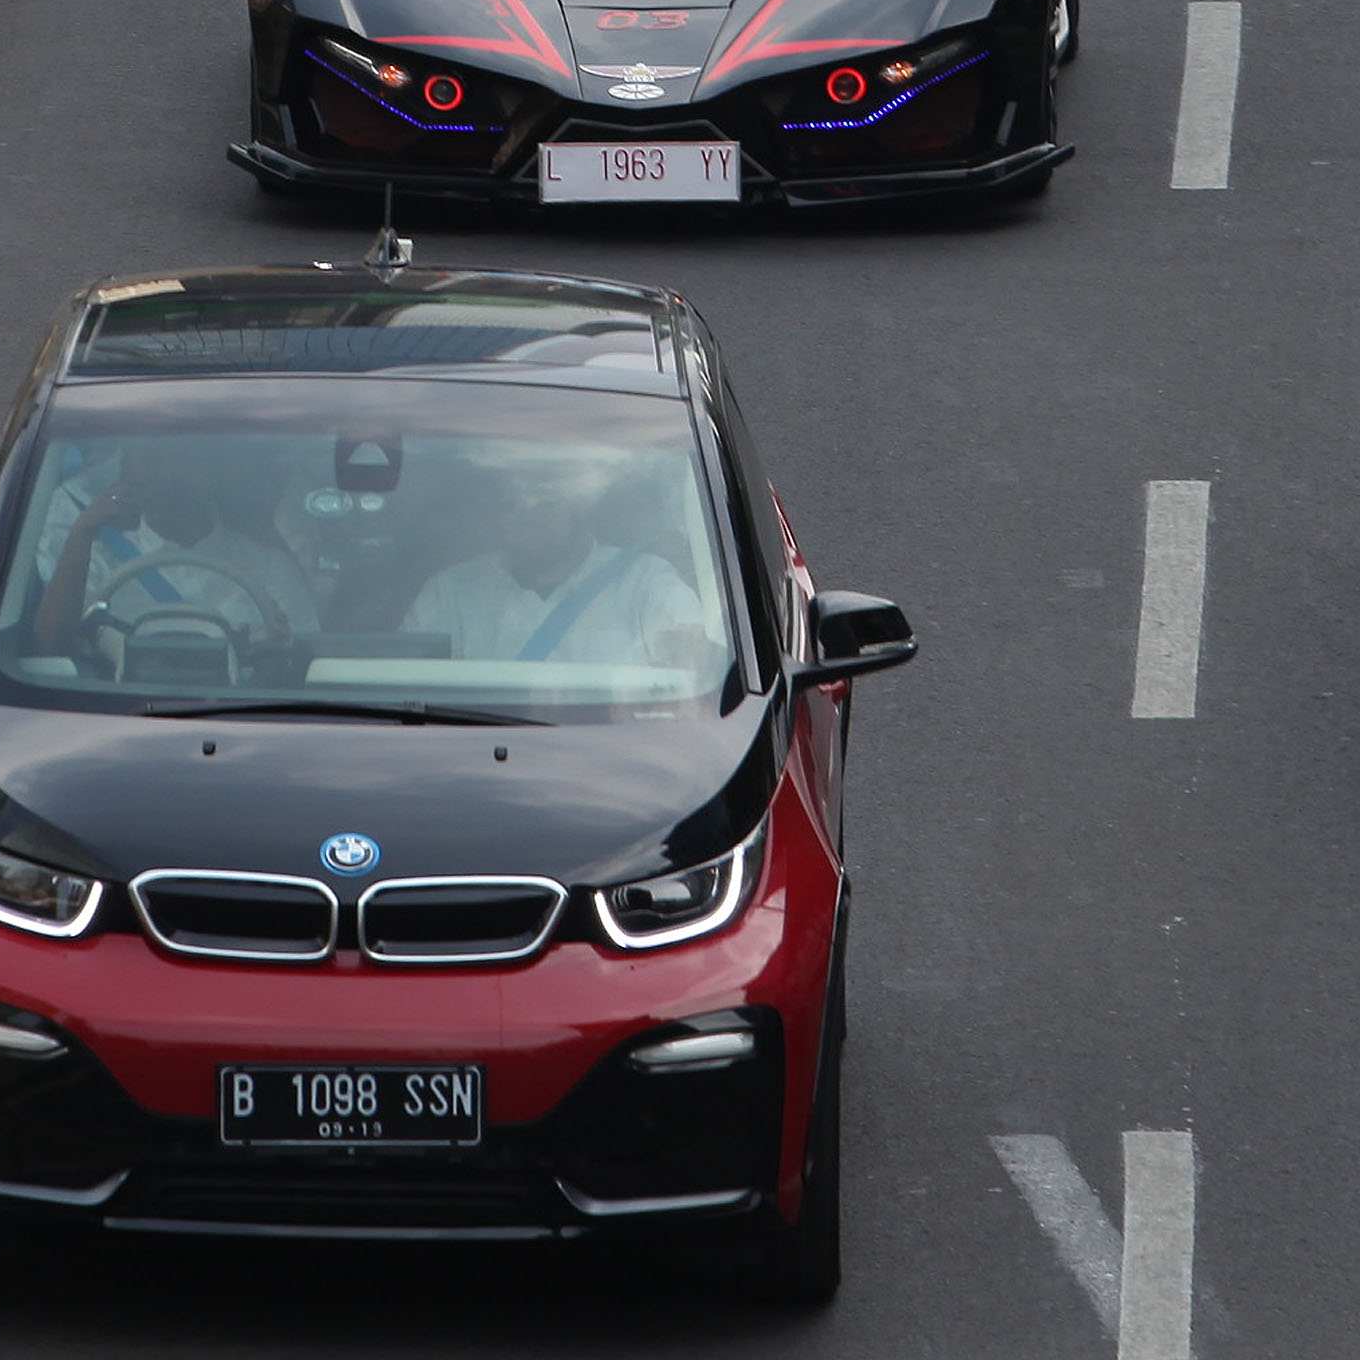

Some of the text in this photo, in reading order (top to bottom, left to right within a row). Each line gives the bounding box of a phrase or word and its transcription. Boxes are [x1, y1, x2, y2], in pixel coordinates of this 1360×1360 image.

[546, 149, 731, 181] L 1963 YY
[234, 1074, 473, 1117] B 1098 SSN
